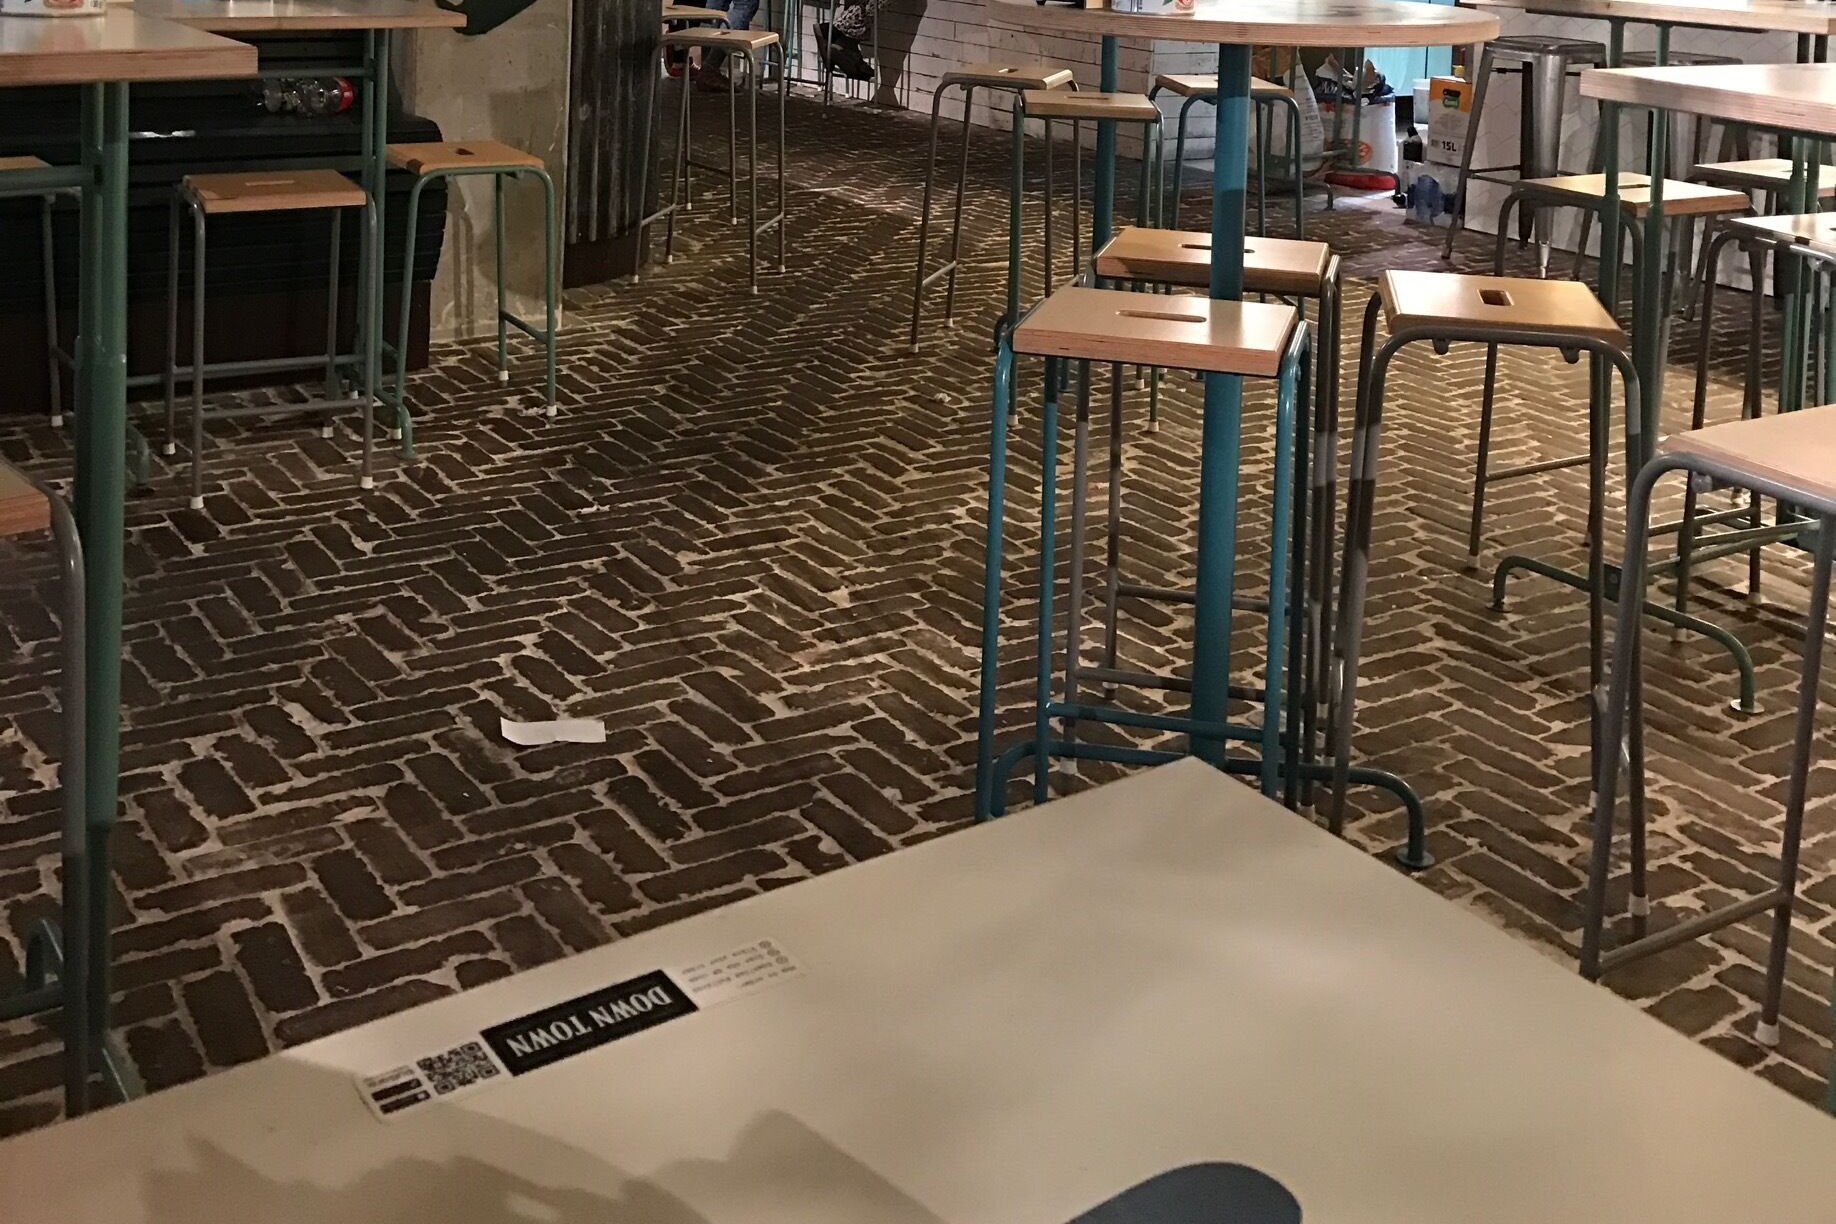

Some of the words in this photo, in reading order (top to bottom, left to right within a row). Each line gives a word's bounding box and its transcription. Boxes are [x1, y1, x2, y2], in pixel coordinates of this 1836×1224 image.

[1441, 140, 1457, 152] 15L
[589, 984, 674, 1029] DOWN
[504, 1014, 592, 1059] TOWN
